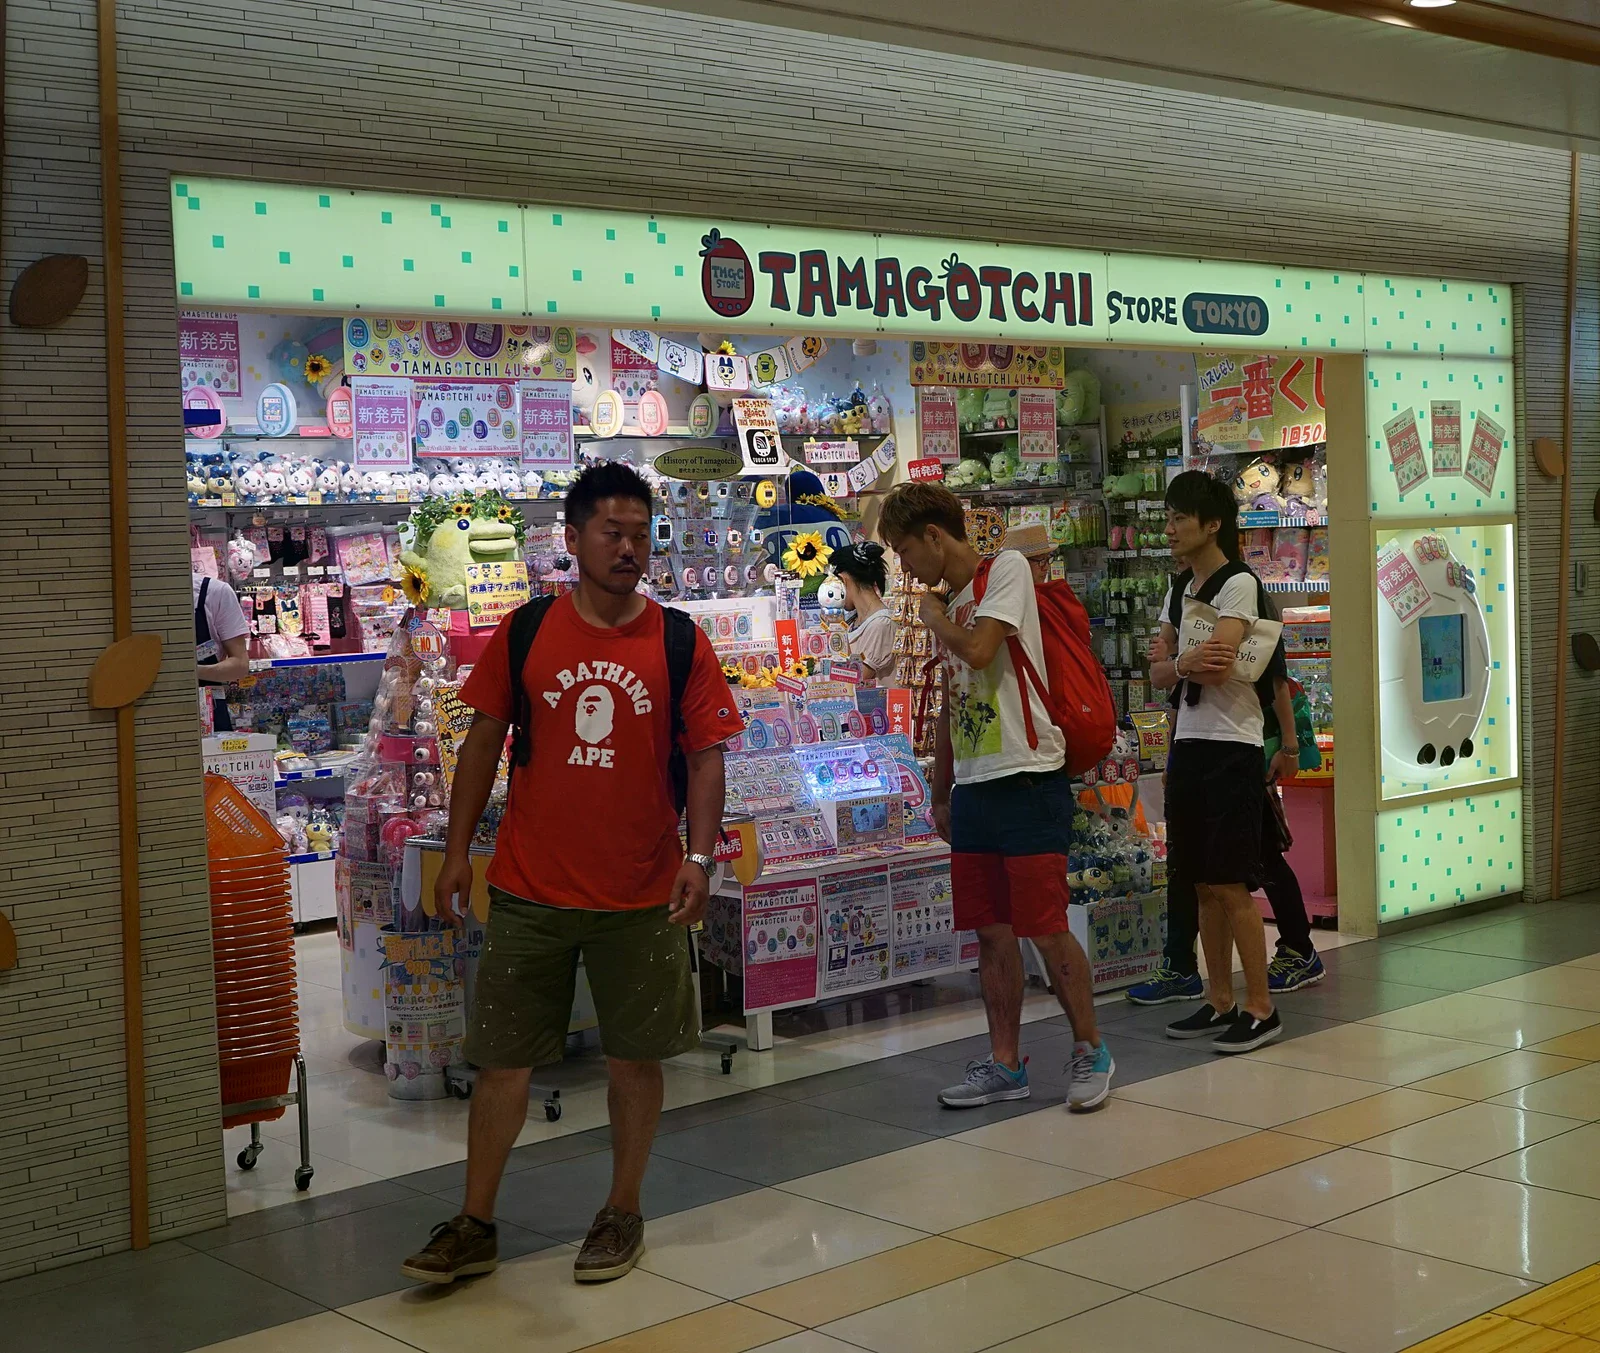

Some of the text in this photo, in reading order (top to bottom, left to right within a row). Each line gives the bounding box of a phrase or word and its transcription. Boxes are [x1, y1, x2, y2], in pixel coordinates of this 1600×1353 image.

[711, 265, 744, 281] TMGC
[716, 279, 741, 290] STORE
[757, 248, 1262, 332] TAMAGOTCHI STORE TOKYO
[180, 310, 222, 319] AMAGOTCHI
[179, 330, 238, 351] 新発売
[402, 360, 499, 378] TAMAGOTCHI
[945, 372, 1011, 385] TAMAGOTCHI
[415, 391, 473, 401] TAMAGOTCHI
[358, 407, 406, 424] 新発売
[524, 408, 568, 426] 新発売
[923, 411, 956, 425] 新発売
[1021, 411, 1054, 426] 新発売
[1281, 424, 1326, 447] 1回50
[1434, 424, 1460, 440] 新発売
[1391, 432, 1419, 459] 新発売
[1473, 433, 1499, 461] 新発売
[663, 456, 737, 467] History of Tamagotchi
[806, 450, 846, 461] TAMAGOTCHI
[909, 465, 943, 479] 新発売
[1378, 561, 1414, 592] 新発売
[1187, 637, 1258, 647] na is
[1236, 649, 1257, 664] tyle
[542, 660, 653, 716] A BATHING
[259, 759, 271, 770] 4U
[567, 745, 616, 769] APE
[1084, 763, 1138, 785] 新発売
[747, 894, 798, 909] TAMAGOTCHI
[747, 916, 788, 927] TAMAGOTCHI
[405, 960, 431, 975] 980
[392, 992, 456, 1005] TAMAGOTCHI
